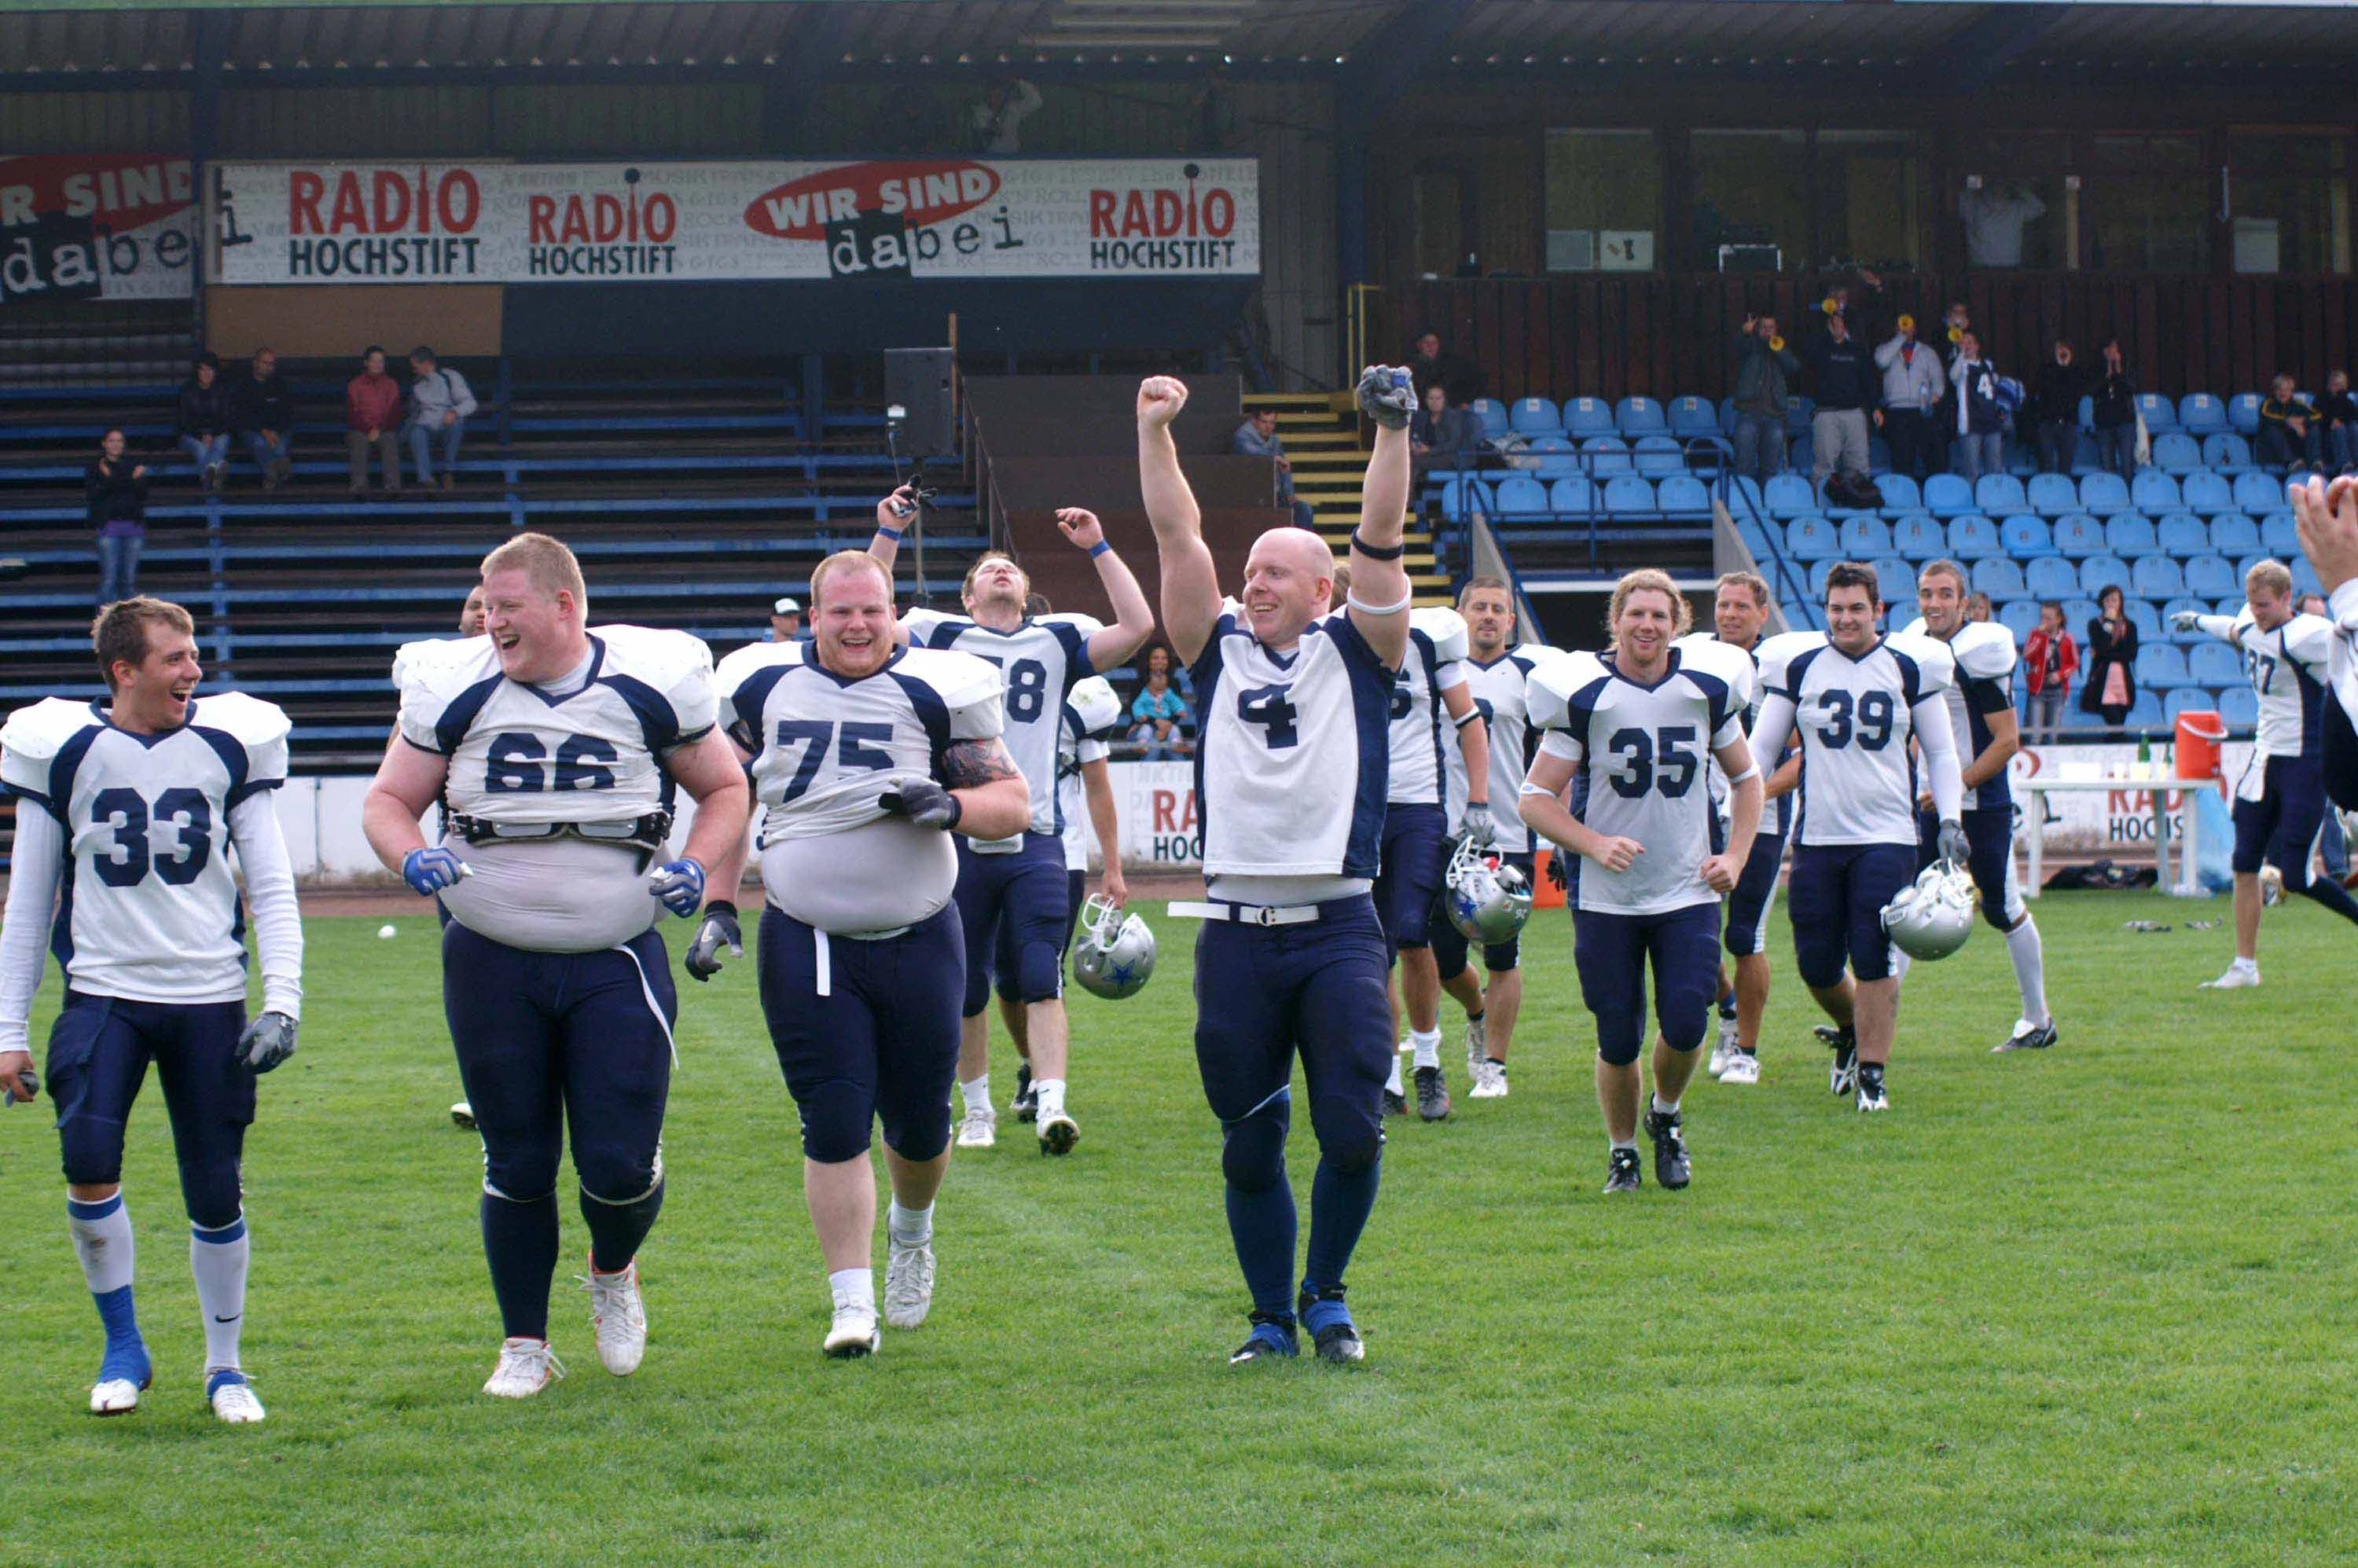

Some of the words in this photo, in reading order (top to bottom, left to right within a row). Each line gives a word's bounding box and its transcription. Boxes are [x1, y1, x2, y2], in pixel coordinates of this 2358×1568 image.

[289, 163, 480, 235] RADIO
[529, 189, 677, 244] RADIO
[764, 190, 860, 231] WIR
[880, 167, 994, 214] SIND
[1089, 187, 1236, 239] RADIO
[289, 238, 480, 276] HOCHSTIFT
[530, 246, 676, 275] HOCHSTIFT
[832, 206, 1024, 273] dabei
[1090, 241, 1235, 269] HOCHSTIFT
[1977, 373, 1993, 400] 4
[1238, 683, 1298, 750] 4
[1817, 689, 1893, 751] 39
[485, 732, 618, 793] 66
[777, 720, 894, 803] 75
[1609, 726, 1698, 799] 35
[91, 788, 211, 887] 33
